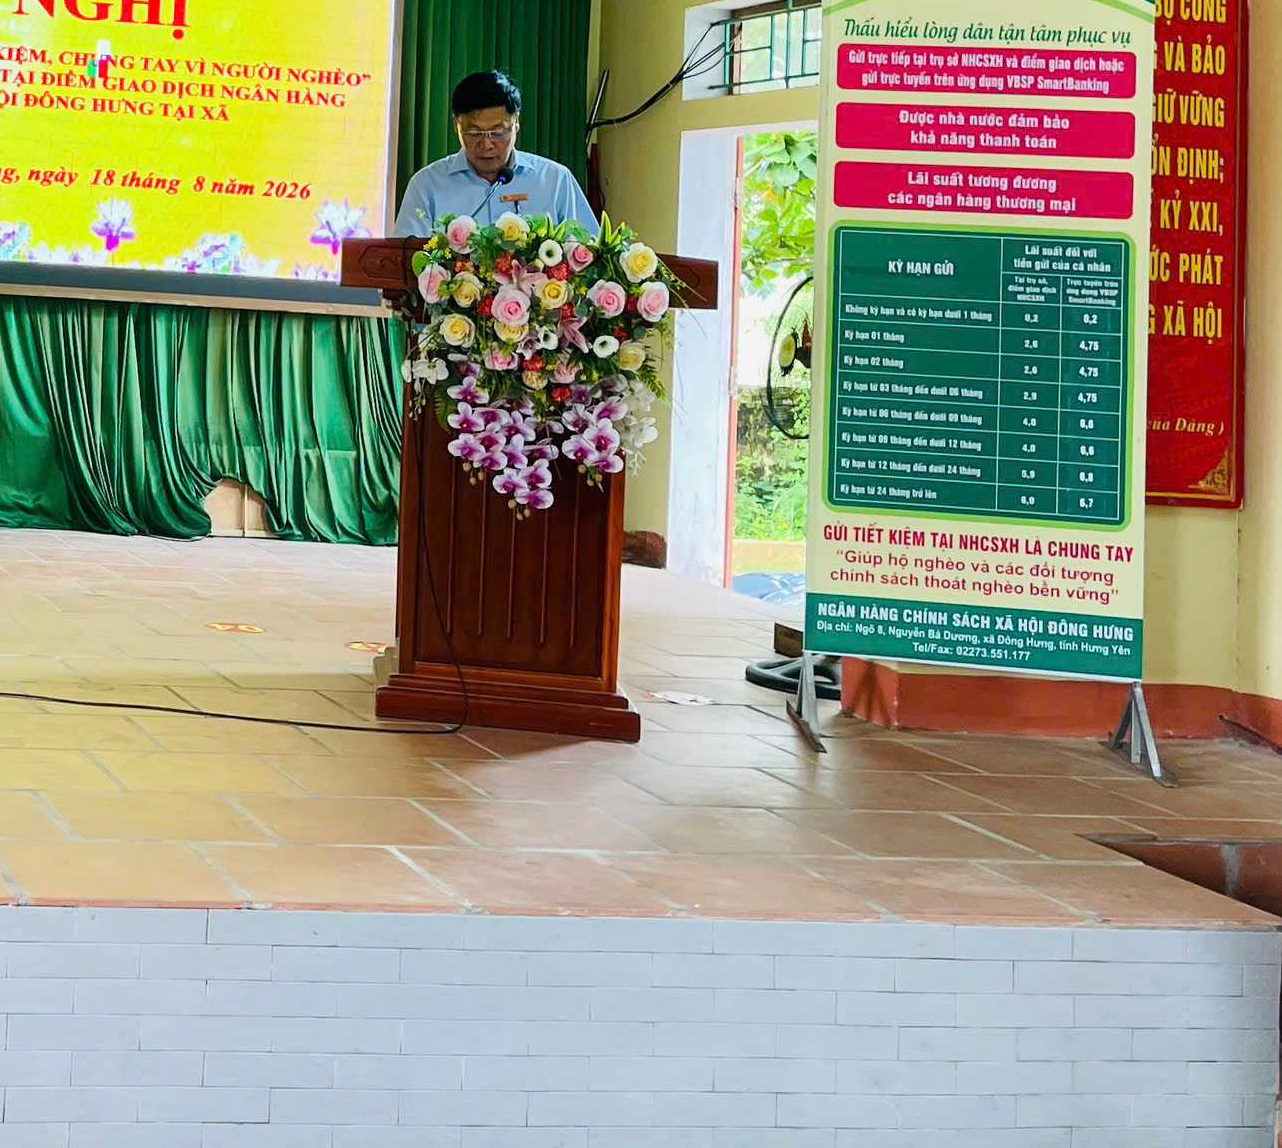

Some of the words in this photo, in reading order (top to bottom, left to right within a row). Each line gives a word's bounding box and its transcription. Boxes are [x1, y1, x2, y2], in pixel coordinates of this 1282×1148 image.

[845, 17, 879, 36] Thấu
[885, 17, 918, 37] hiểu
[924, 21, 958, 43] lòng
[963, 23, 993, 39] dân
[999, 24, 1024, 44] tận
[1030, 25, 1061, 42] tâm
[1067, 27, 1106, 46] phục
[1113, 32, 1130, 44] vụ
[141, 58, 176, 72] TAY
[185, 58, 205, 75] VÌ
[213, 63, 281, 80] NGƯỜI
[288, 68, 371, 86] NGHÈO”
[24, 91, 84, 110] ĐÔNG
[92, 98, 153, 115] HƯNG
[160, 103, 194, 121] TẠI
[201, 104, 228, 121] XÃ
[911, 130, 935, 144] khả
[941, 132, 975, 148] năng
[980, 133, 1020, 147] thanh
[1025, 135, 1056, 148] toán
[28, 167, 78, 187] ngày
[92, 170, 115, 185] 18
[121, 172, 181, 194] tháng
[193, 176, 205, 192] 8
[211, 179, 254, 195] năm
[262, 181, 310, 199] 2026
[824, 524, 847, 541] GỬI
[854, 524, 884, 543] TIẾT
[889, 529, 925, 551] KIỆM
[931, 532, 953, 552] TẠI
[959, 534, 1019, 553] NHCSXH
[1025, 540, 1042, 555] LÀ
[1048, 541, 1100, 560] CHUNG
[1106, 545, 1133, 562] TAY
[836, 550, 882, 567] “Giúp
[889, 553, 908, 567] hộ
[915, 557, 965, 572] nghèo
[972, 564, 989, 572] và
[996, 565, 1022, 575] các
[1030, 564, 1054, 578] đối
[1062, 568, 1113, 586] tượng
[913, 642, 953, 653] Tel/Fax:
